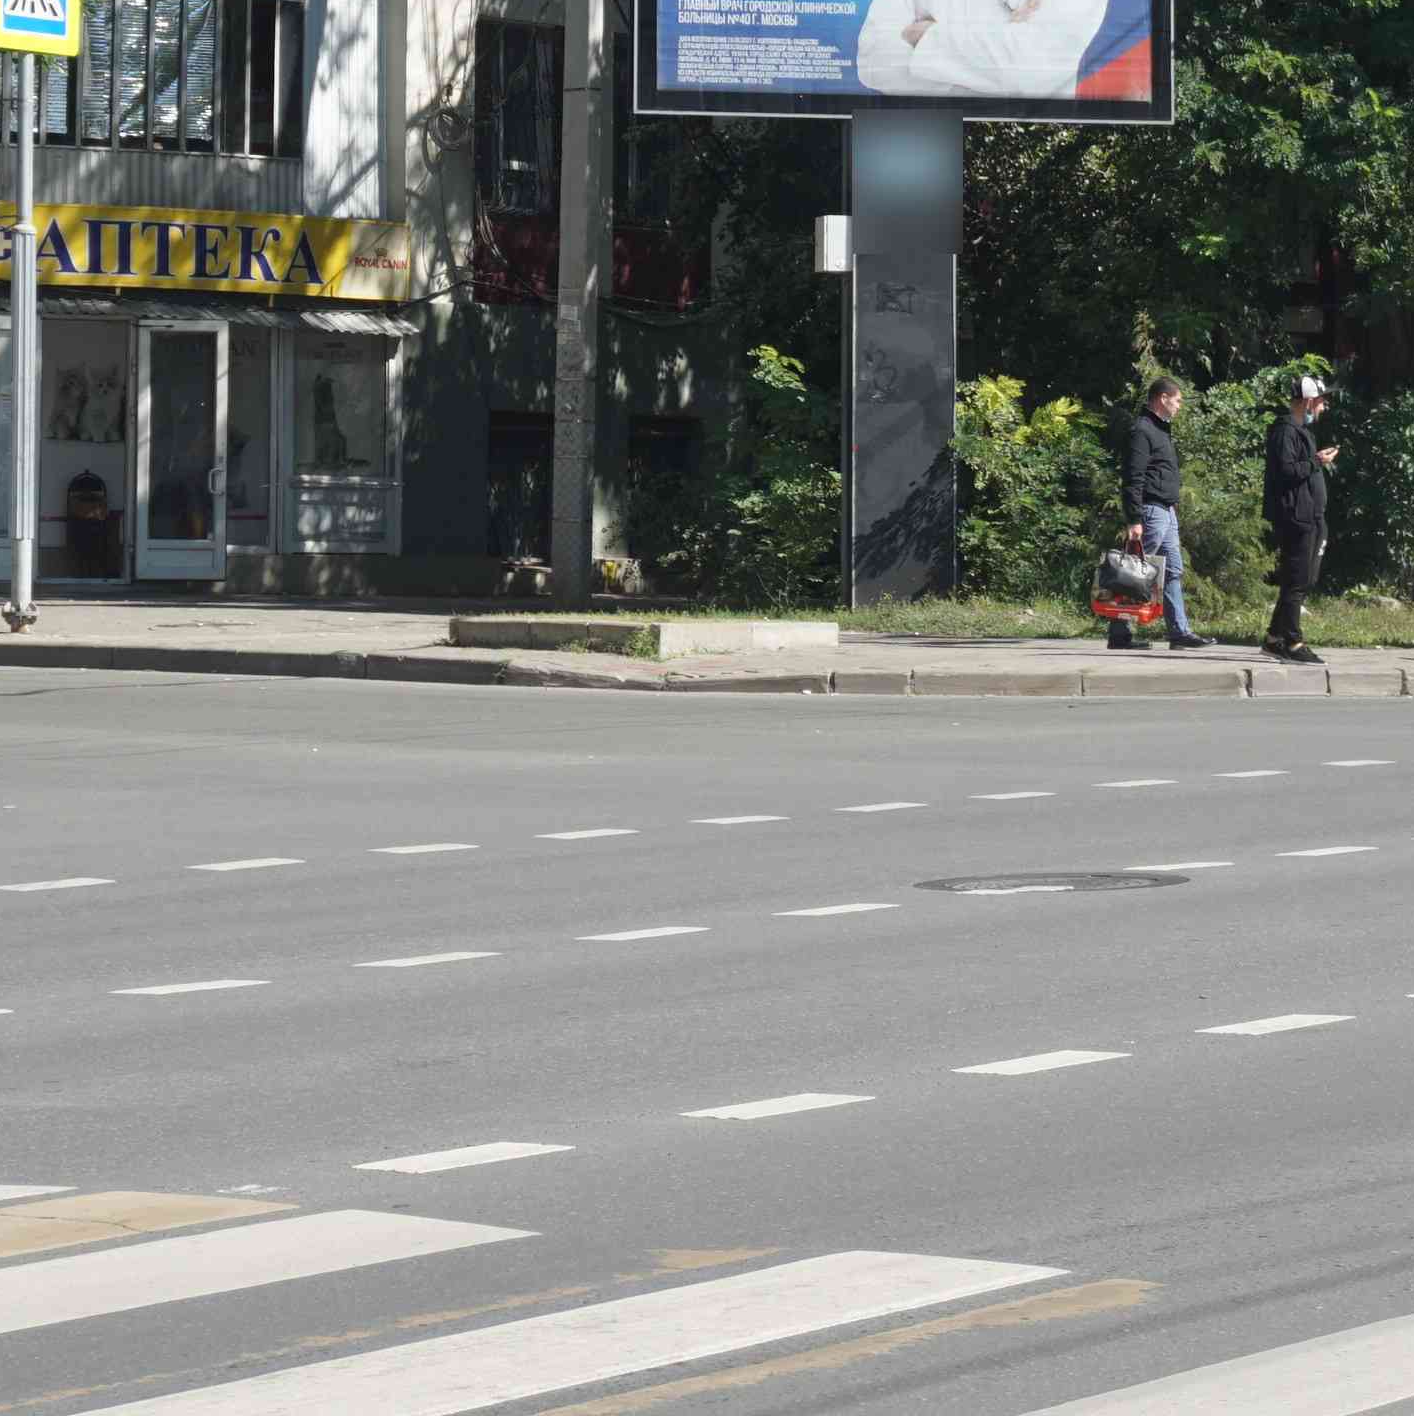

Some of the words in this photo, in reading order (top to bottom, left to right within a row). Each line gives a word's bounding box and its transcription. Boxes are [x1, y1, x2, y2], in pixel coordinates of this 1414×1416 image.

[720, 0, 743, 12] ВРАЧ
[744, 0, 794, 13] ГОРОДСКОЙ
[678, 12, 725, 25] БОЛЬНИЦЫ
[761, 14, 798, 26] МОСКВЫ
[36, 218, 325, 284] АПТЕКА
